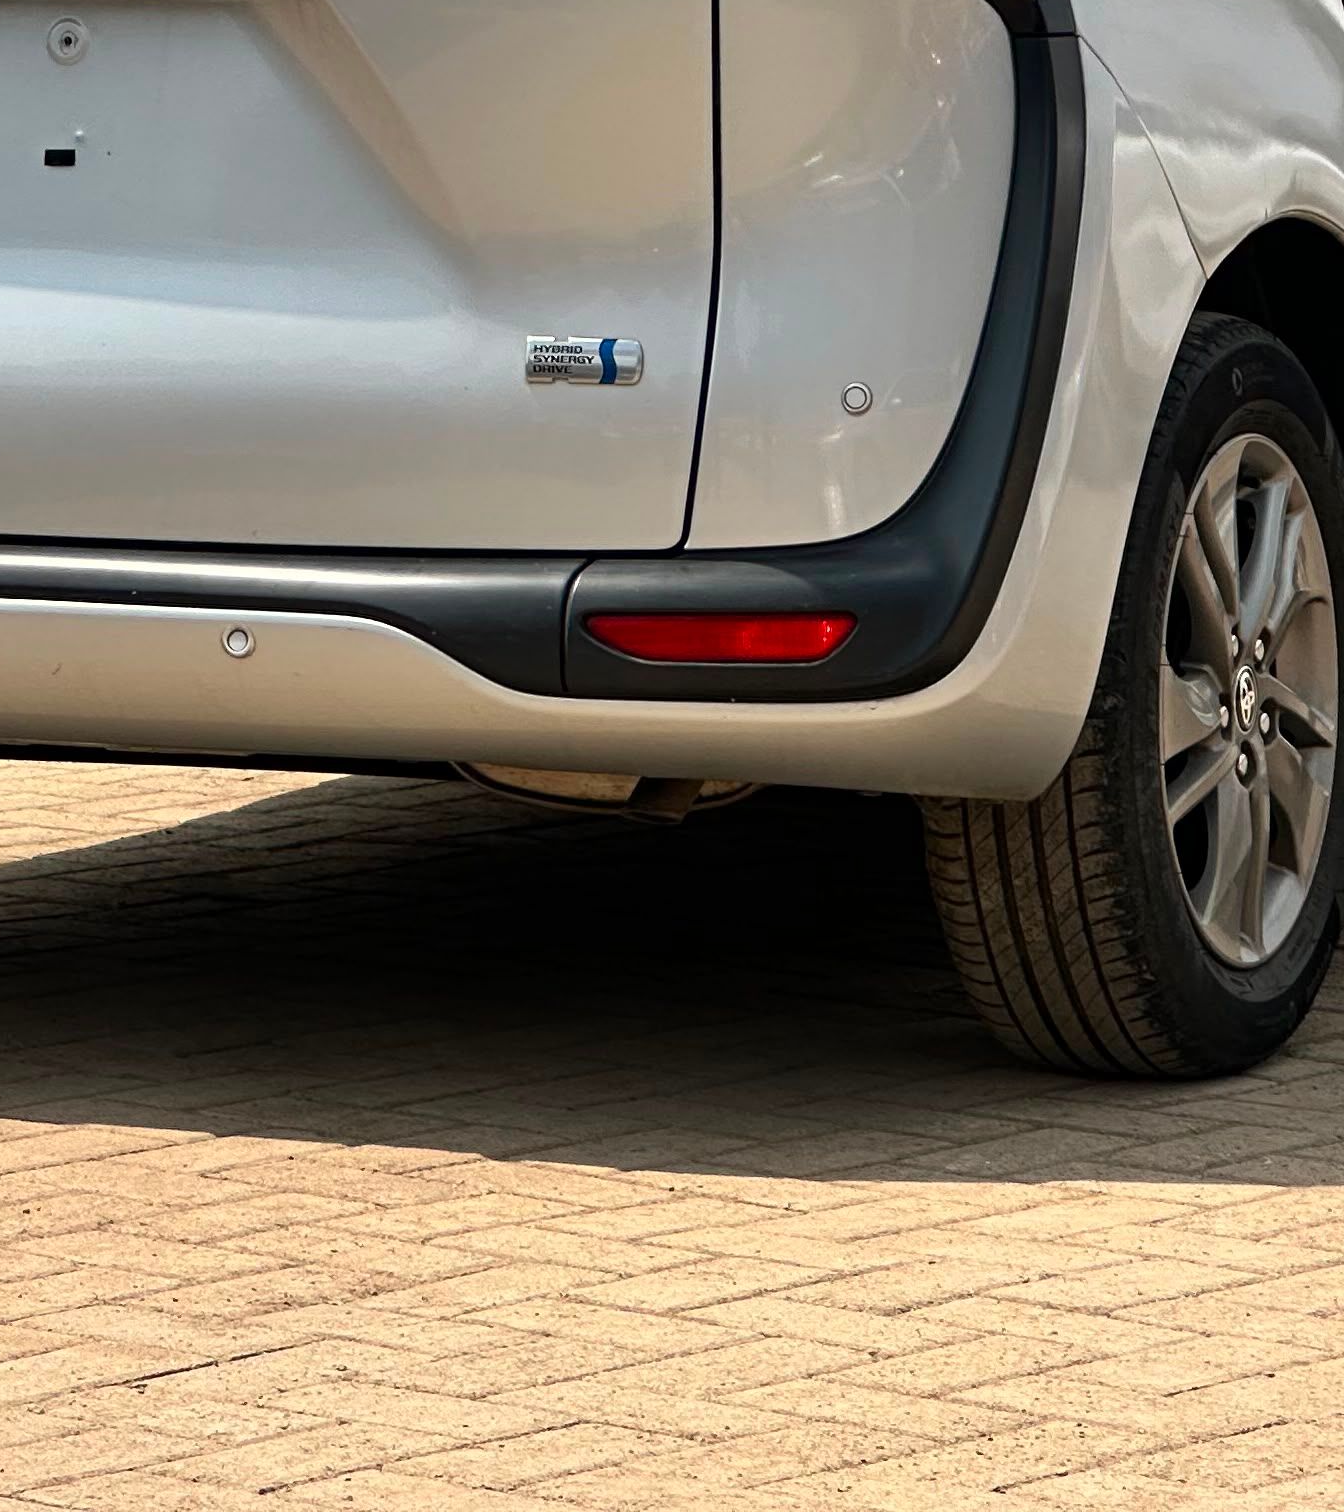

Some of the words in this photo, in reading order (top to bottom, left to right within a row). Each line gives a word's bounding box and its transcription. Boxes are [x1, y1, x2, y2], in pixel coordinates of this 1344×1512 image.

[533, 344, 583, 354] HYBRID
[532, 355, 595, 364] SYNERGY
[532, 364, 574, 374] DRIVE
